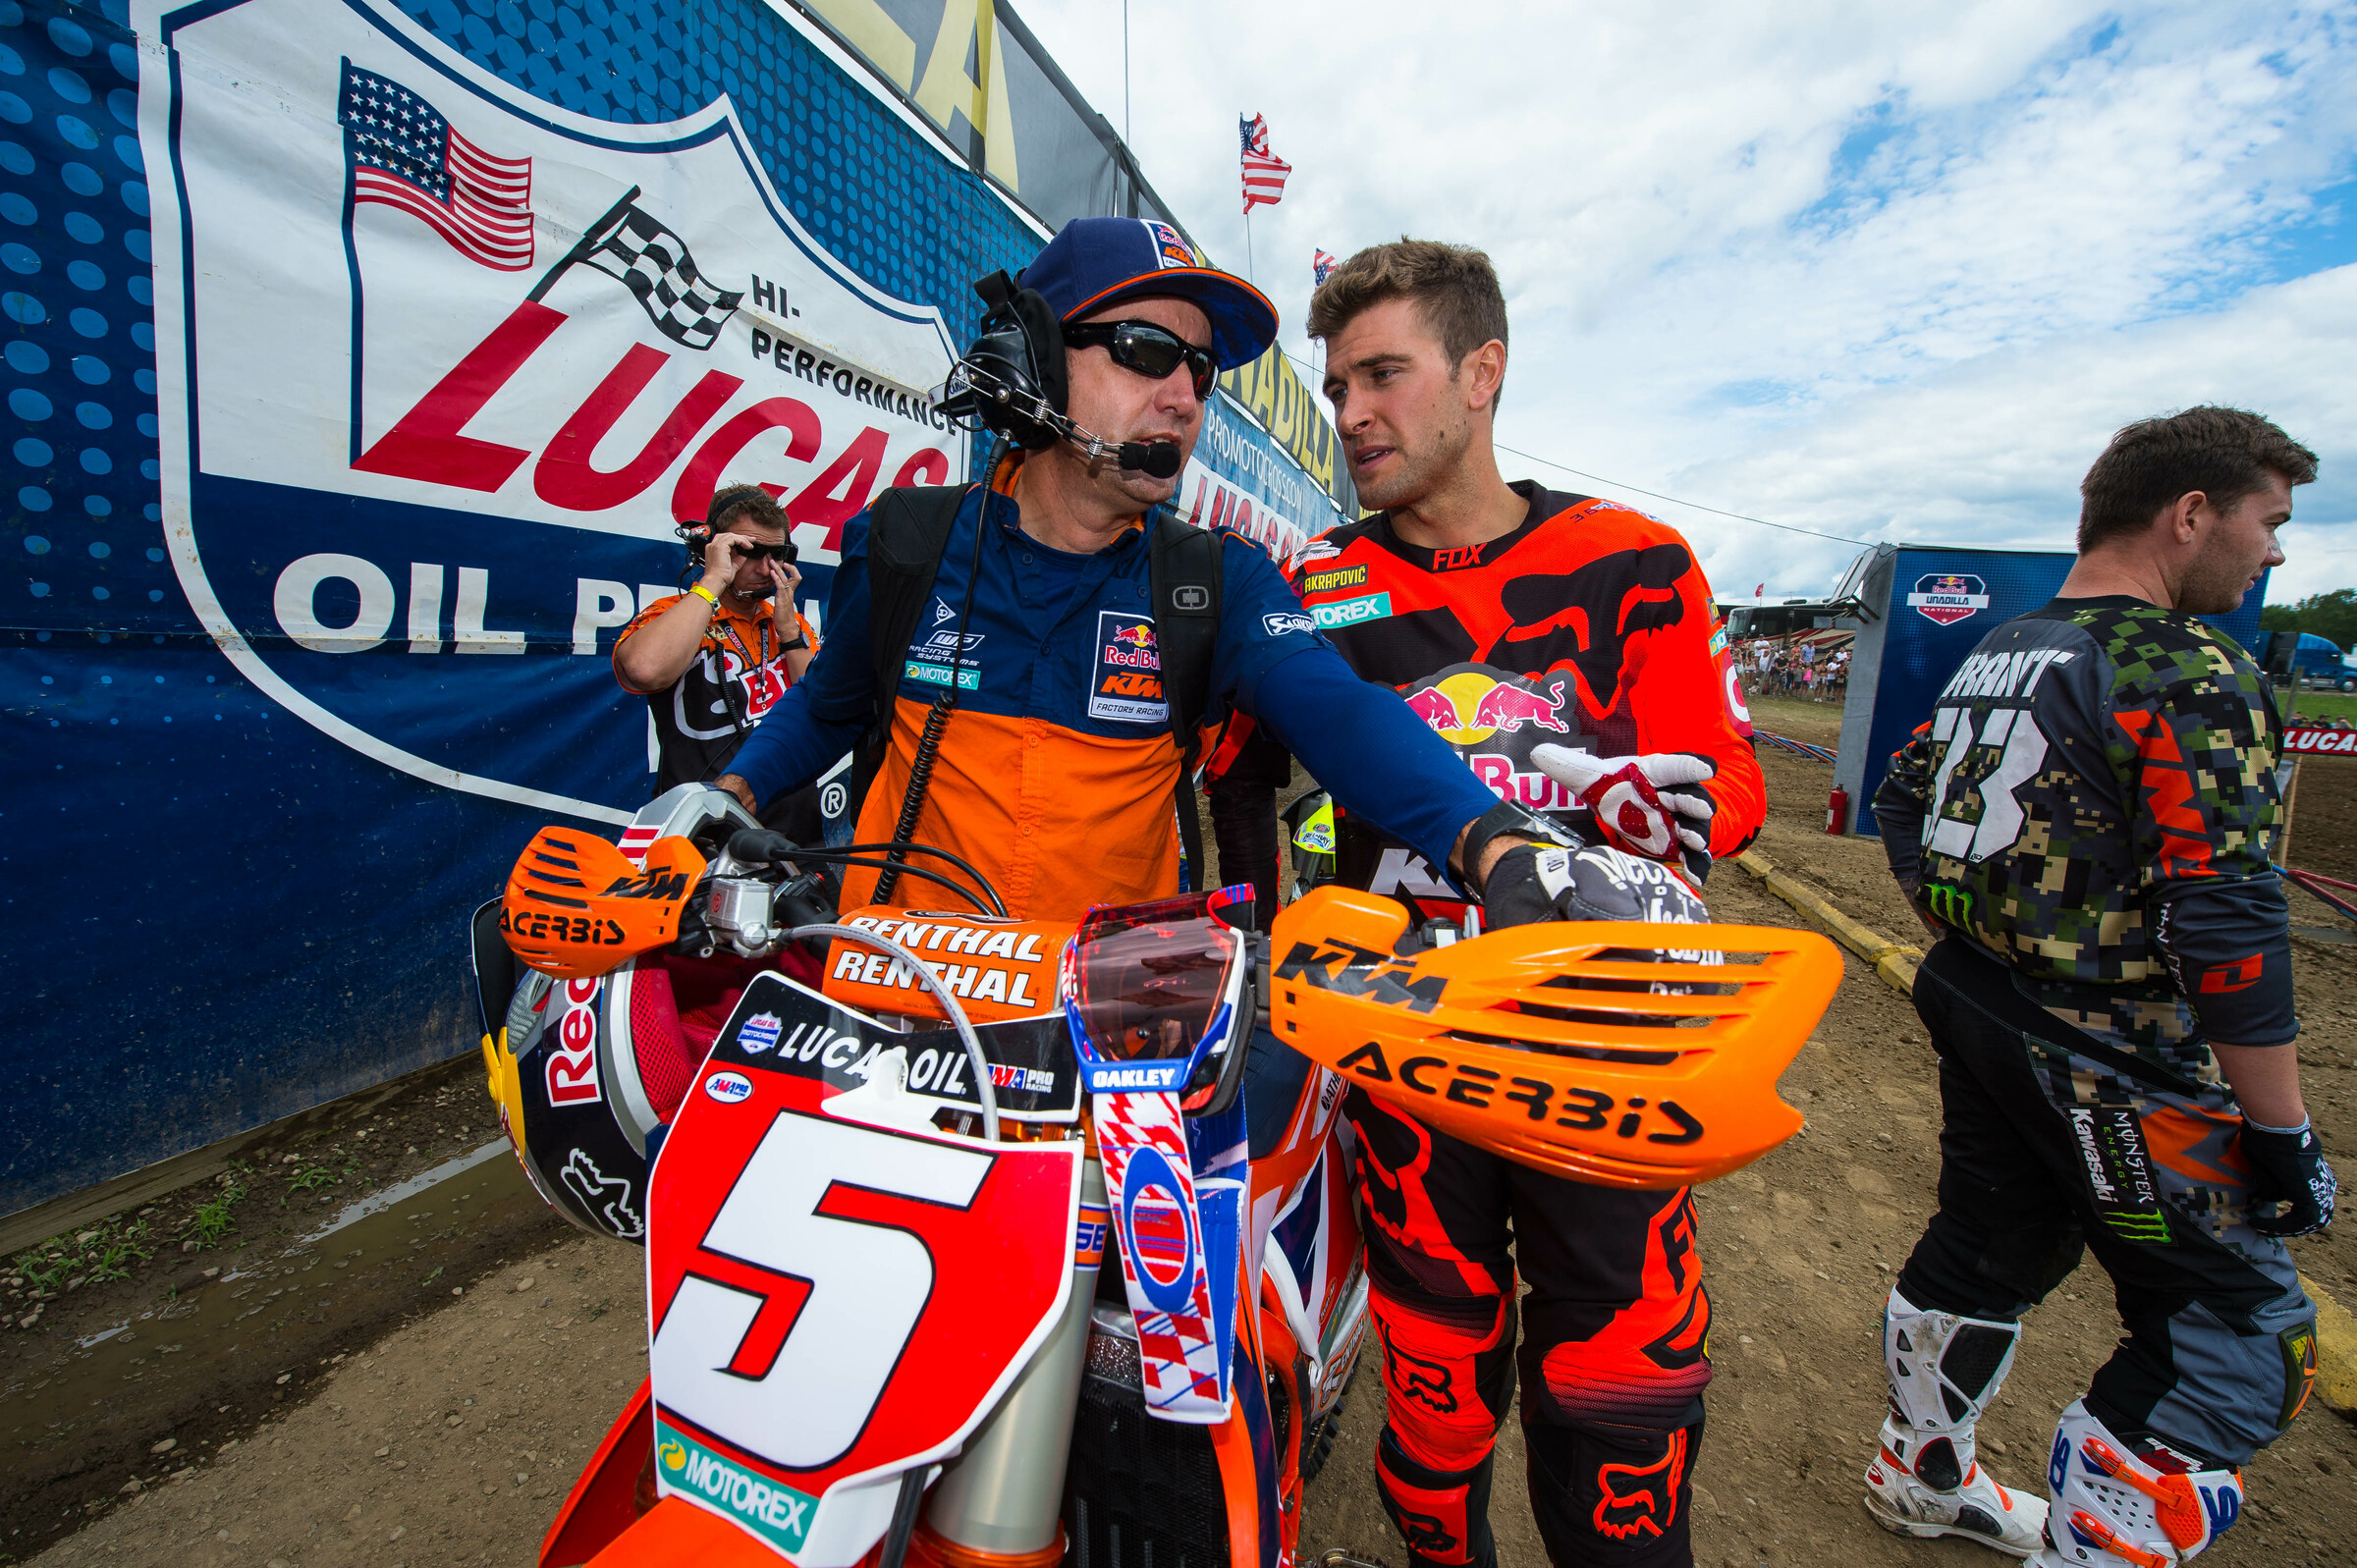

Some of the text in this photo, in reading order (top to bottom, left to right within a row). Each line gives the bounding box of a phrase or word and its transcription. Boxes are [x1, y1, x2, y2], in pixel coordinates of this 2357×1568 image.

[1164, 246, 1195, 267] KTM
[751, 273, 800, 319] HI-
[751, 327, 958, 436] PERFORMANCE
[1433, 543, 1488, 571] FOX
[1304, 566, 1366, 593] AKRAPOVIČ
[273, 553, 525, 655] OIL
[1311, 598, 1380, 626] TOREX
[1926, 595, 1969, 605] UNADILLA
[908, 645, 952, 656] RACING
[1104, 645, 1139, 667] Red
[1100, 672, 1163, 698] KTM
[1096, 703, 1164, 716] FACTORY RACING
[2283, 730, 2357, 753] LUCA
[595, 866, 690, 901] KTM
[841, 916, 1043, 963] RENTHAL
[832, 949, 1036, 1009] RENTHAL
[1273, 938, 1449, 1016] KTM
[778, 1022, 968, 1095] LUCA OIL
[708, 1078, 749, 1095] AMA PRO
[1025, 1083, 1053, 1094] RACING
[1026, 1069, 1055, 1086] PRO
[1092, 1069, 1176, 1088] OAKLEY
[2069, 1108, 2118, 1203] Kawasaki
[2104, 1126, 2129, 1189] ENERGY
[2113, 1111, 2155, 1204] MONSTER
[656, 1109, 1000, 1473] 5
[685, 1449, 808, 1538] MOTOREX
